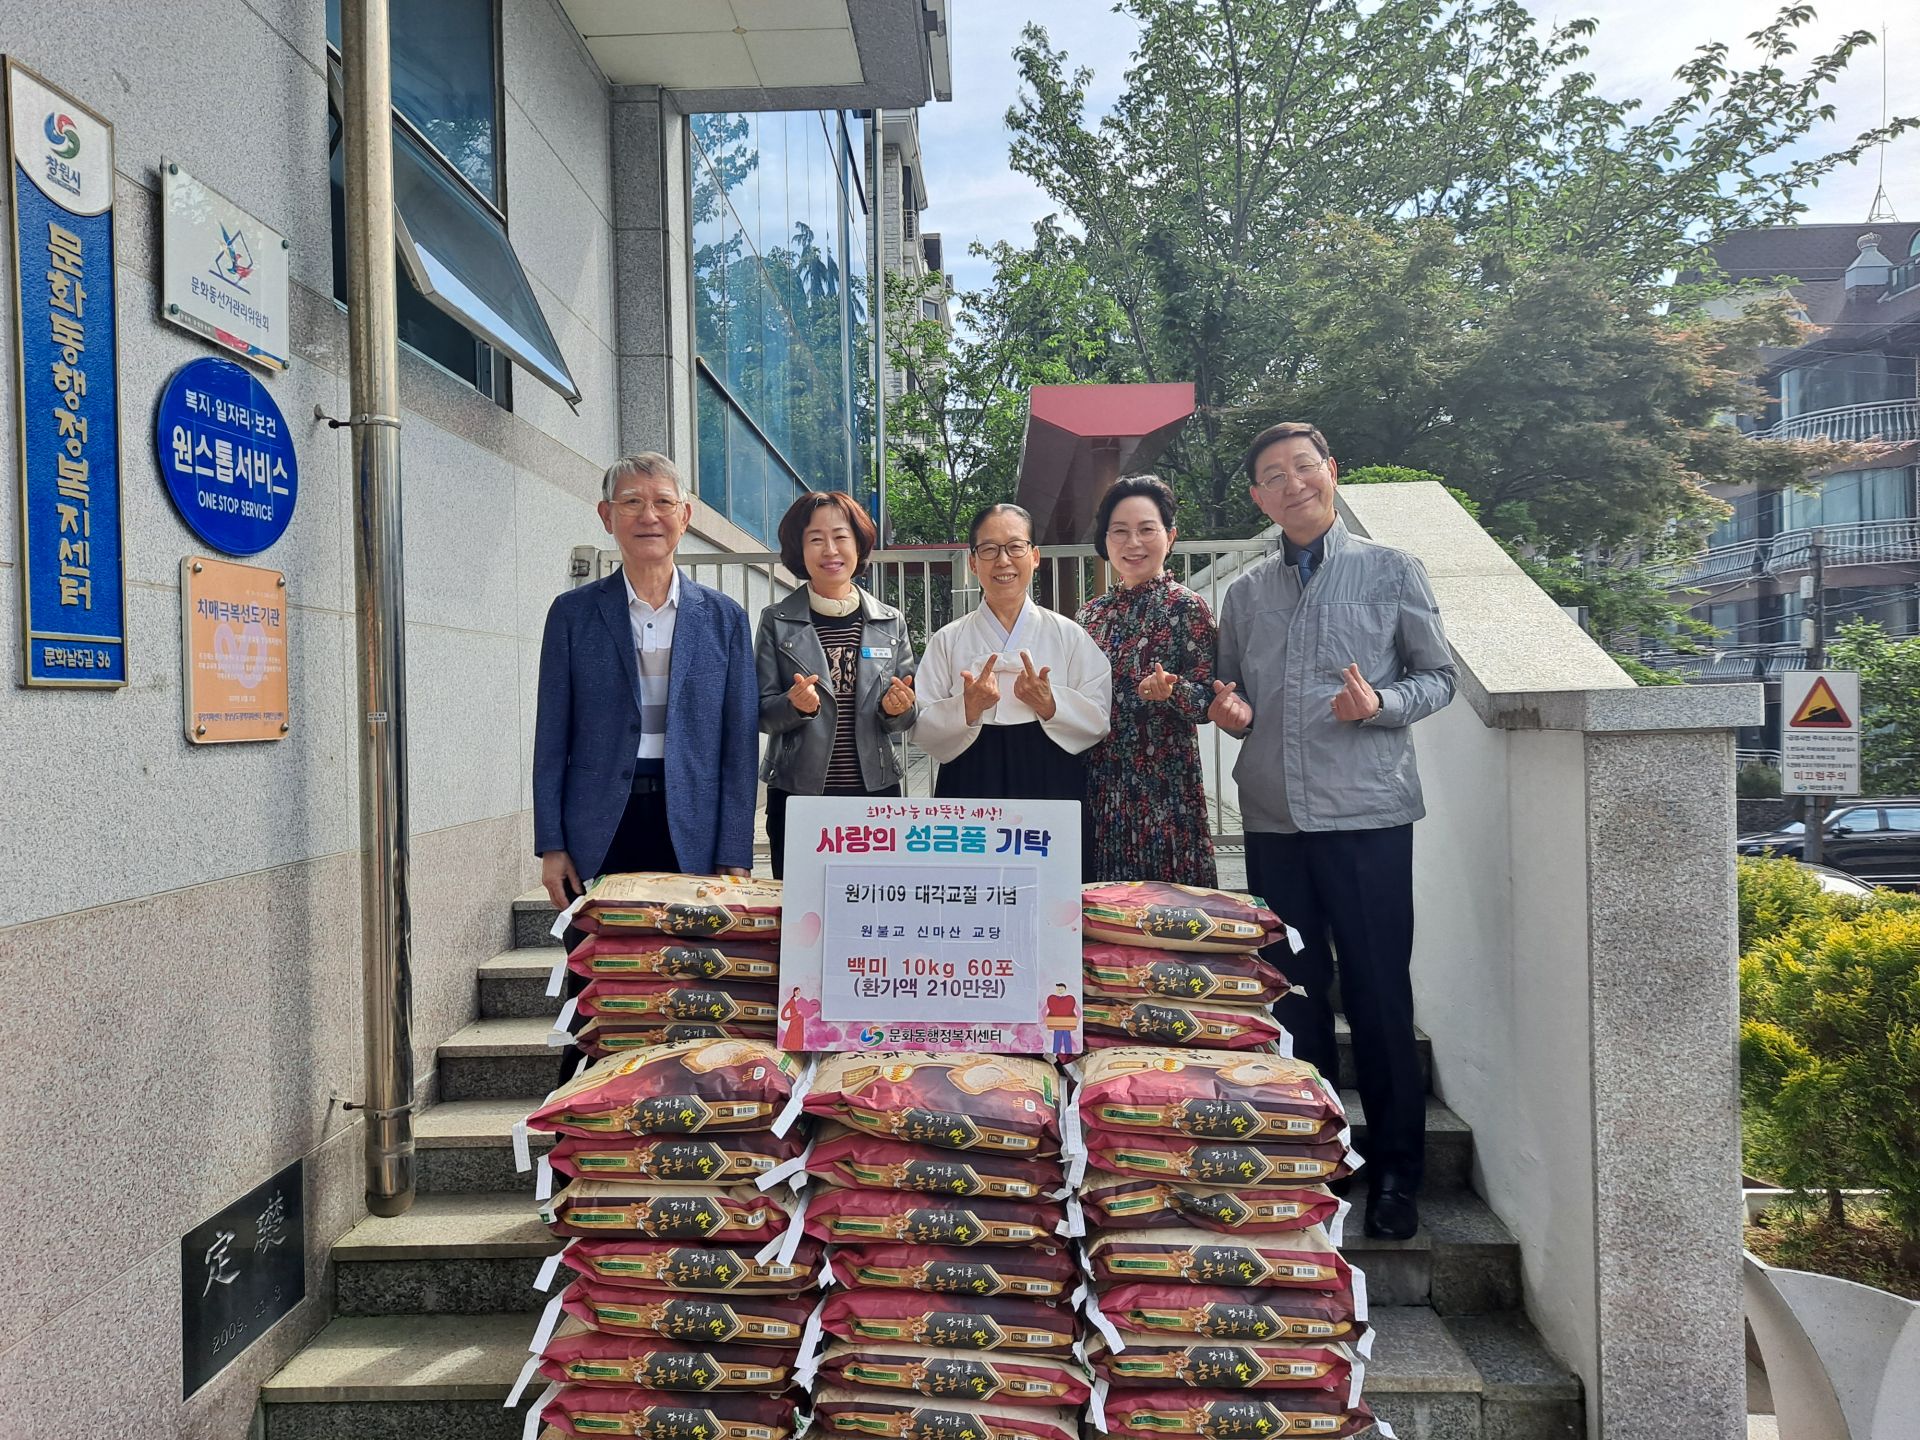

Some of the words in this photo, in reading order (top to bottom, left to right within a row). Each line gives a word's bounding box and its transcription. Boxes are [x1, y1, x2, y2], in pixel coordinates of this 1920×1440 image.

[45, 155, 81, 190] 창원시
[191, 276, 270, 333] 문화동선거관리위원회
[47, 222, 92, 611] 문화동행정복지센터
[172, 425, 289, 496] 원스톱서비스
[198, 490, 217, 508] ONE
[218, 495, 239, 514] STOP
[241, 500, 273, 521] SERVICE
[197, 598, 280, 627] 치매극복선도기관
[1793, 770, 1847, 781] 미끄럼주의
[866, 804, 921, 820] 희망나눔
[925, 804, 967, 820] 따뜻한
[970, 806, 1003, 821] 세상!
[816, 825, 897, 854] 사랑의
[905, 825, 987, 854] 성금품
[995, 828, 1052, 857] 기탁
[844, 883, 906, 904] 원기109
[915, 884, 978, 905] 대각교절
[986, 885, 1018, 905] 기념
[847, 957, 888, 977] 백미
[902, 958, 955, 977] 10kg
[968, 958, 1014, 977] 60포
[853, 978, 918, 998] (환가액
[926, 978, 1006, 999] 210만원)
[888, 1028, 1002, 1044] 문화동행정복지센터
